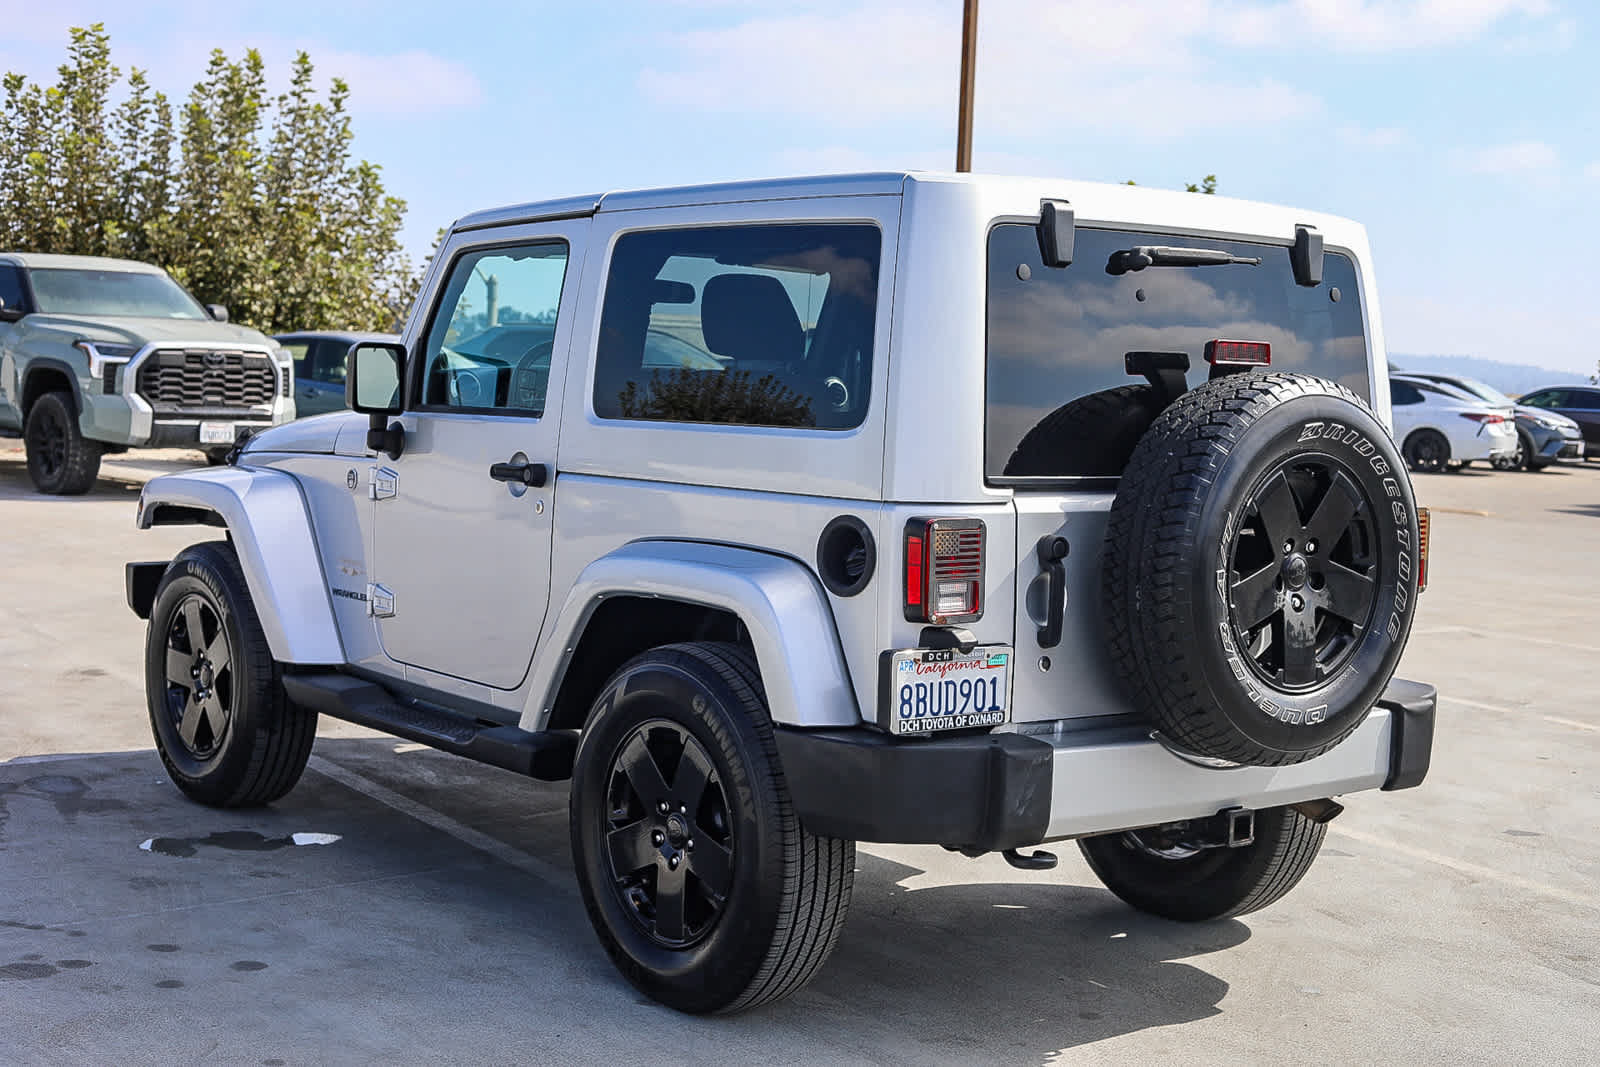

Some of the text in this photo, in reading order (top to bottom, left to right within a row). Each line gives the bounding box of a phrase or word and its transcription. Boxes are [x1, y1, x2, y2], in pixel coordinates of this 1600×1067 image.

[1297, 422, 1411, 641] BRIDGESTONE
[332, 587, 367, 601] WRANGLE
[899, 660, 914, 672] APR
[928, 653, 950, 661] DCH
[915, 660, 982, 678] California
[1218, 622, 1328, 726] DUELER
[900, 676, 1000, 719] 8BUD901
[900, 711, 1004, 732] DCH TOYOTA OF OXNARD
